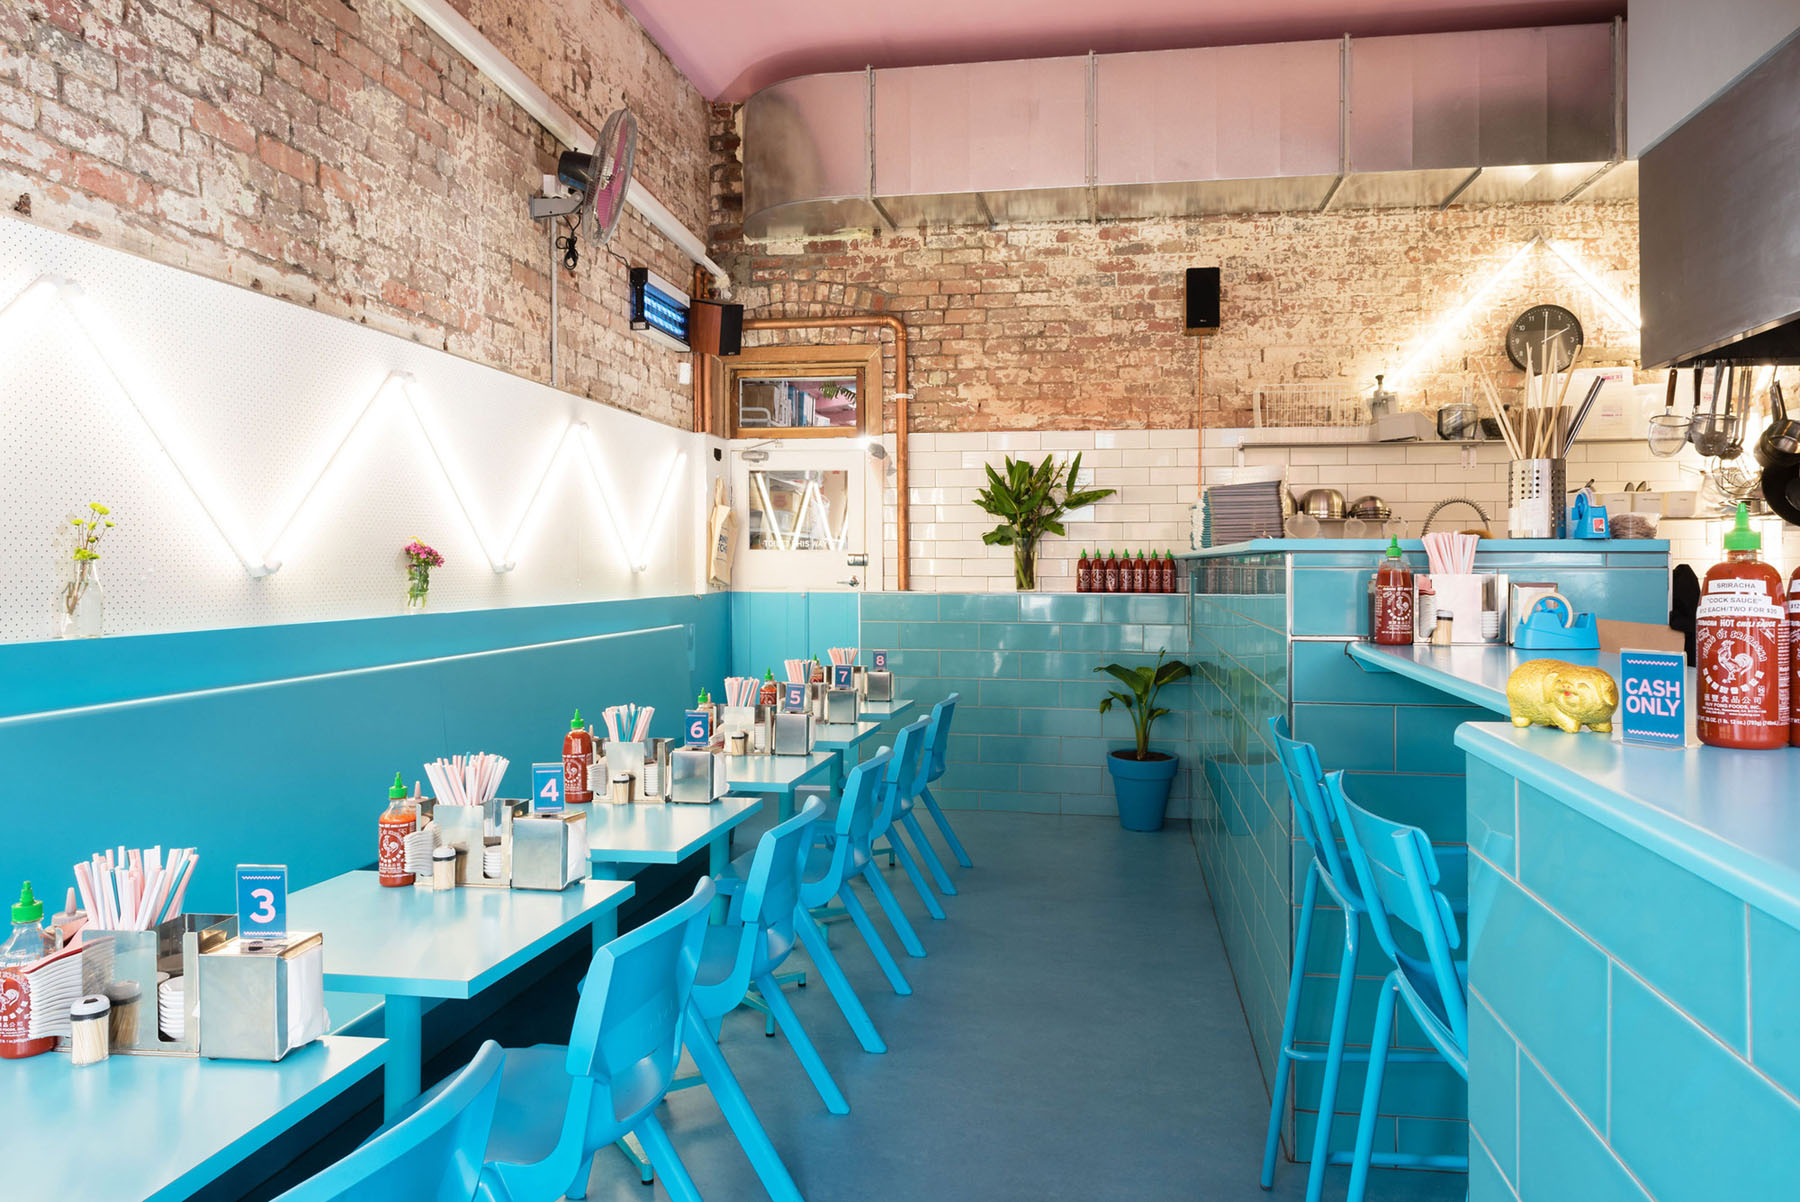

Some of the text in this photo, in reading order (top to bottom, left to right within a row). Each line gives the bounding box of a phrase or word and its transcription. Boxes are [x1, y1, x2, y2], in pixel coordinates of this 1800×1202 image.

[1720, 619, 1735, 627] HOT
[876, 655, 884, 665] 8
[838, 671, 848, 683] 7
[790, 690, 800, 704] 5
[1625, 678, 1680, 698] CASH
[1626, 695, 1680, 717] ONLY
[690, 720, 704, 738] 6
[540, 778, 559, 801] 4
[249, 888, 276, 923] 3
